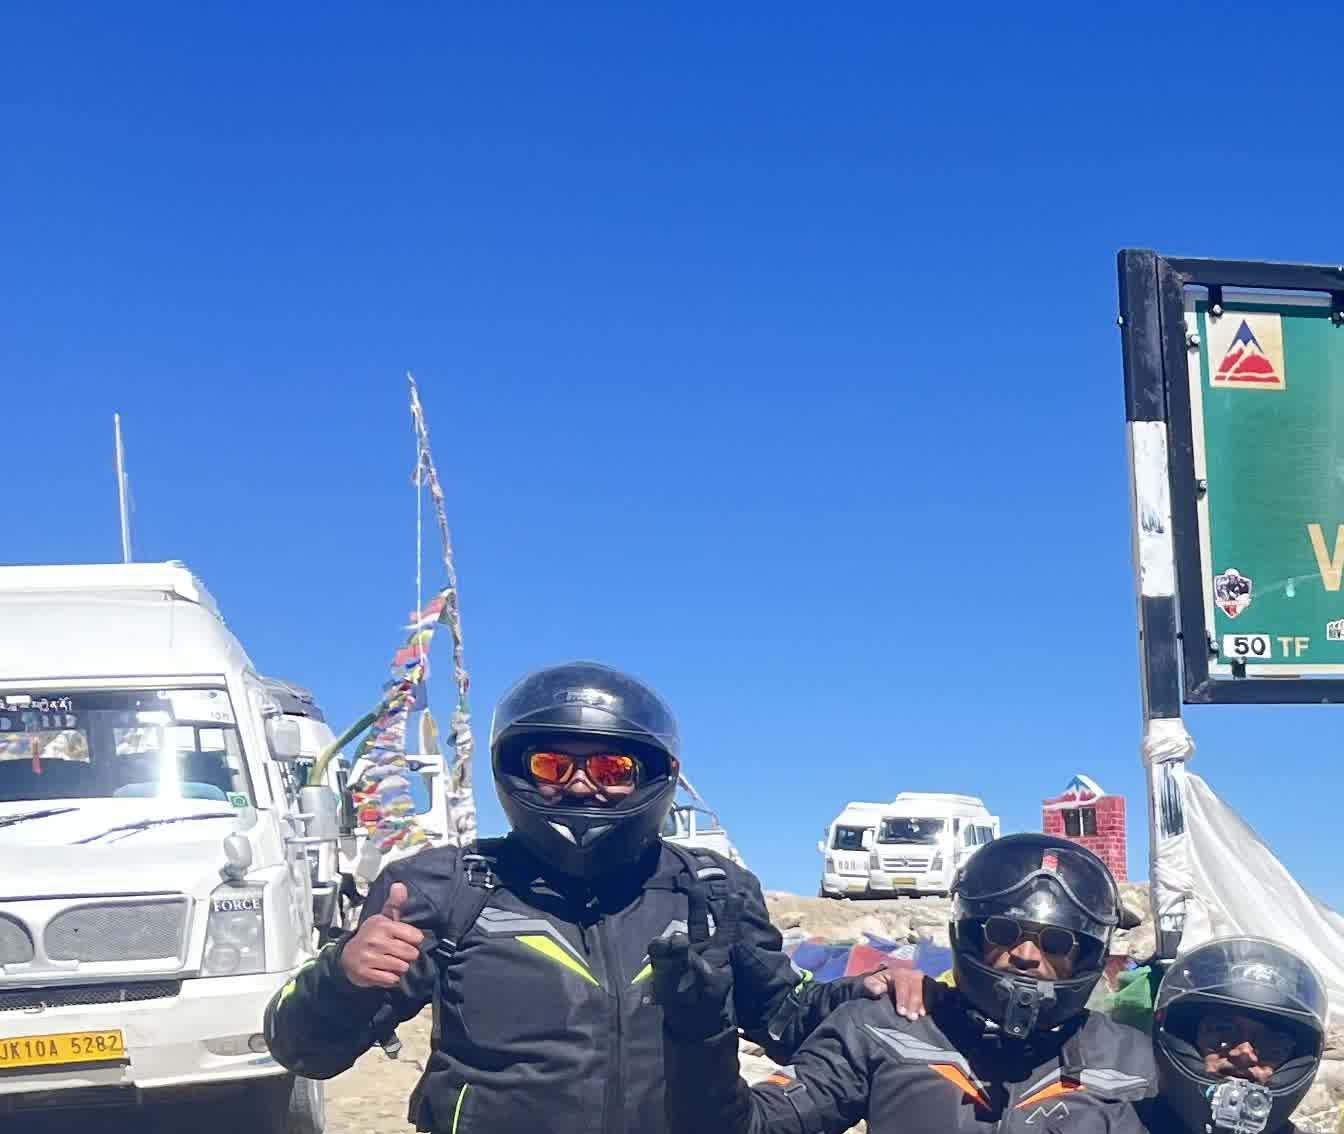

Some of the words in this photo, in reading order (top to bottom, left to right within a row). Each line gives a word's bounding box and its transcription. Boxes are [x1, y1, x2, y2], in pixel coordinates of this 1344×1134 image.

[1233, 636, 1266, 656] 50
[1276, 636, 1311, 657] TF
[213, 898, 261, 913] FORCE
[70, 1035, 119, 1054] 5282
